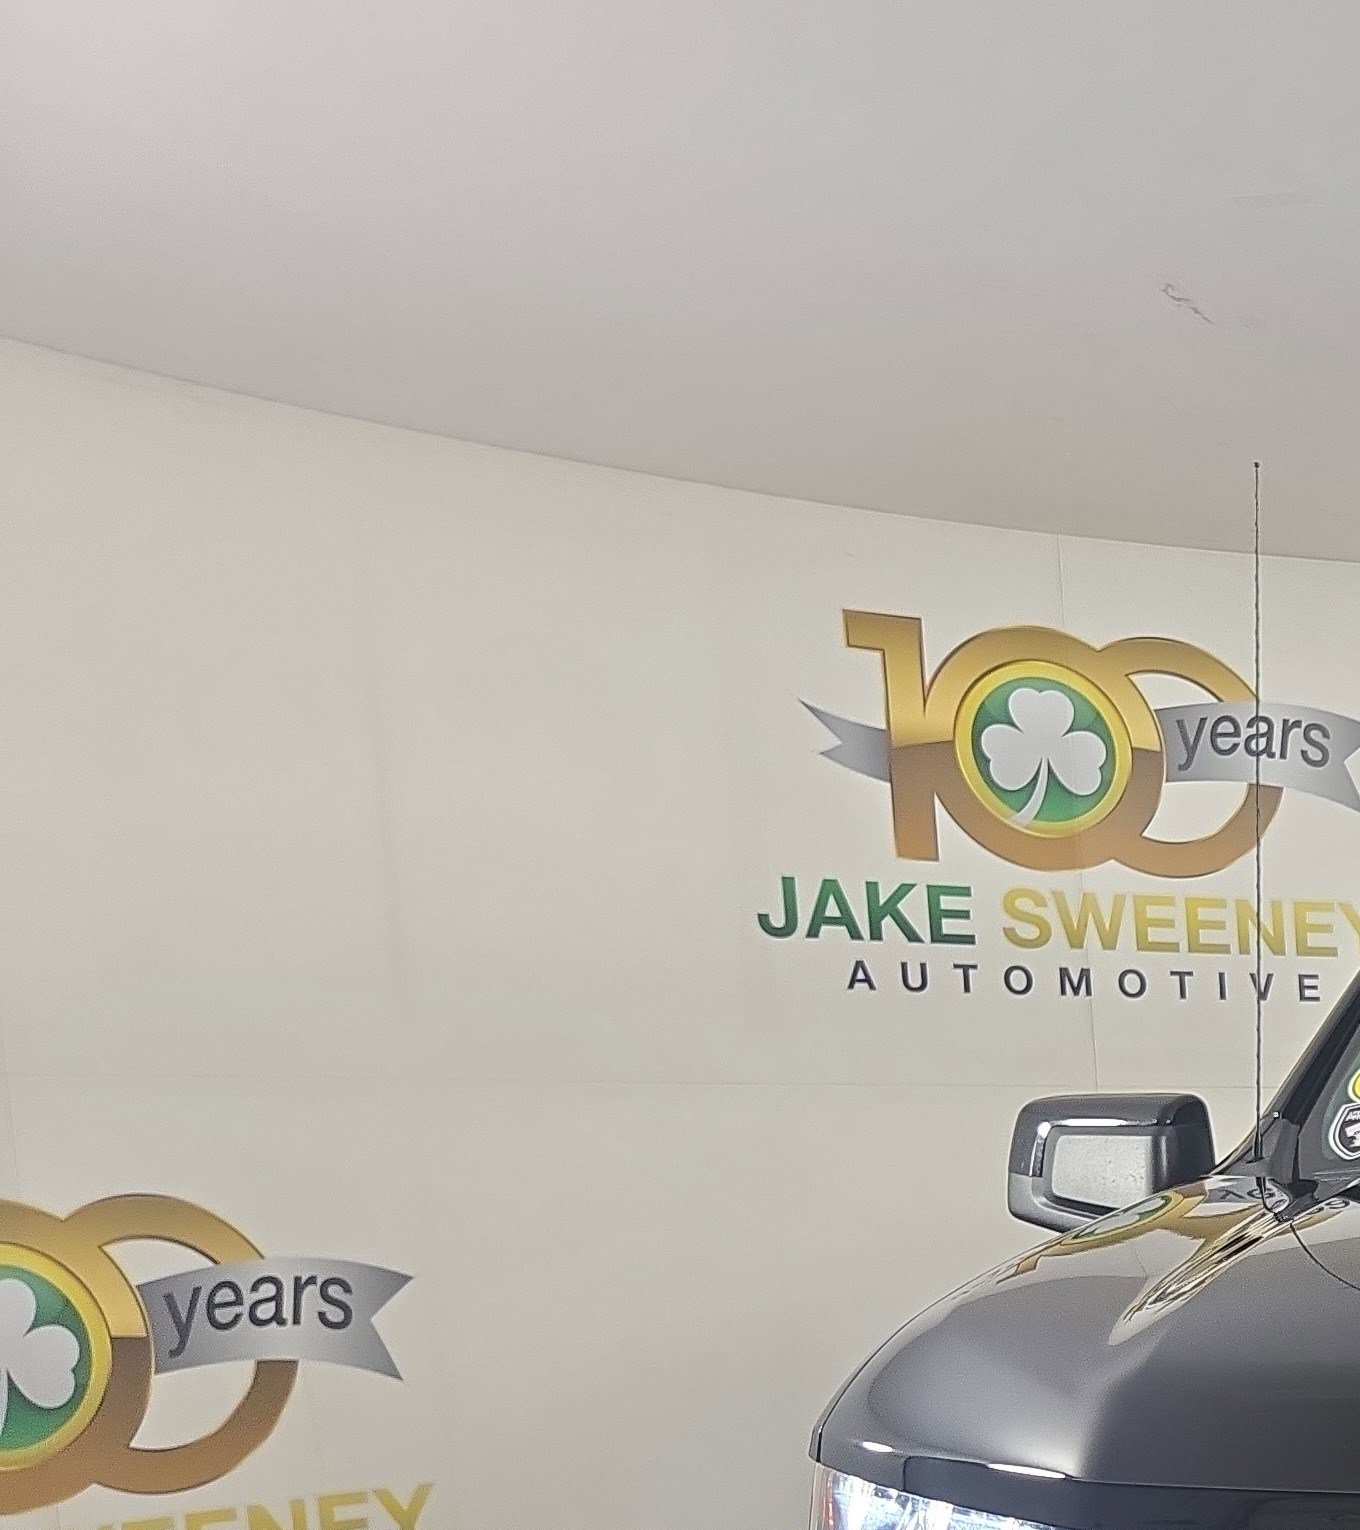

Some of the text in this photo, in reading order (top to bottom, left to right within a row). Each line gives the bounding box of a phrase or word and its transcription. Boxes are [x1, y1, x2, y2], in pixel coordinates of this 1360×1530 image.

[842, 608, 1331, 879] 100 years
[757, 876, 976, 946] JAKE
[847, 959, 1321, 1003] AUTOMOTIVE
[163, 1273, 354, 1359] years
